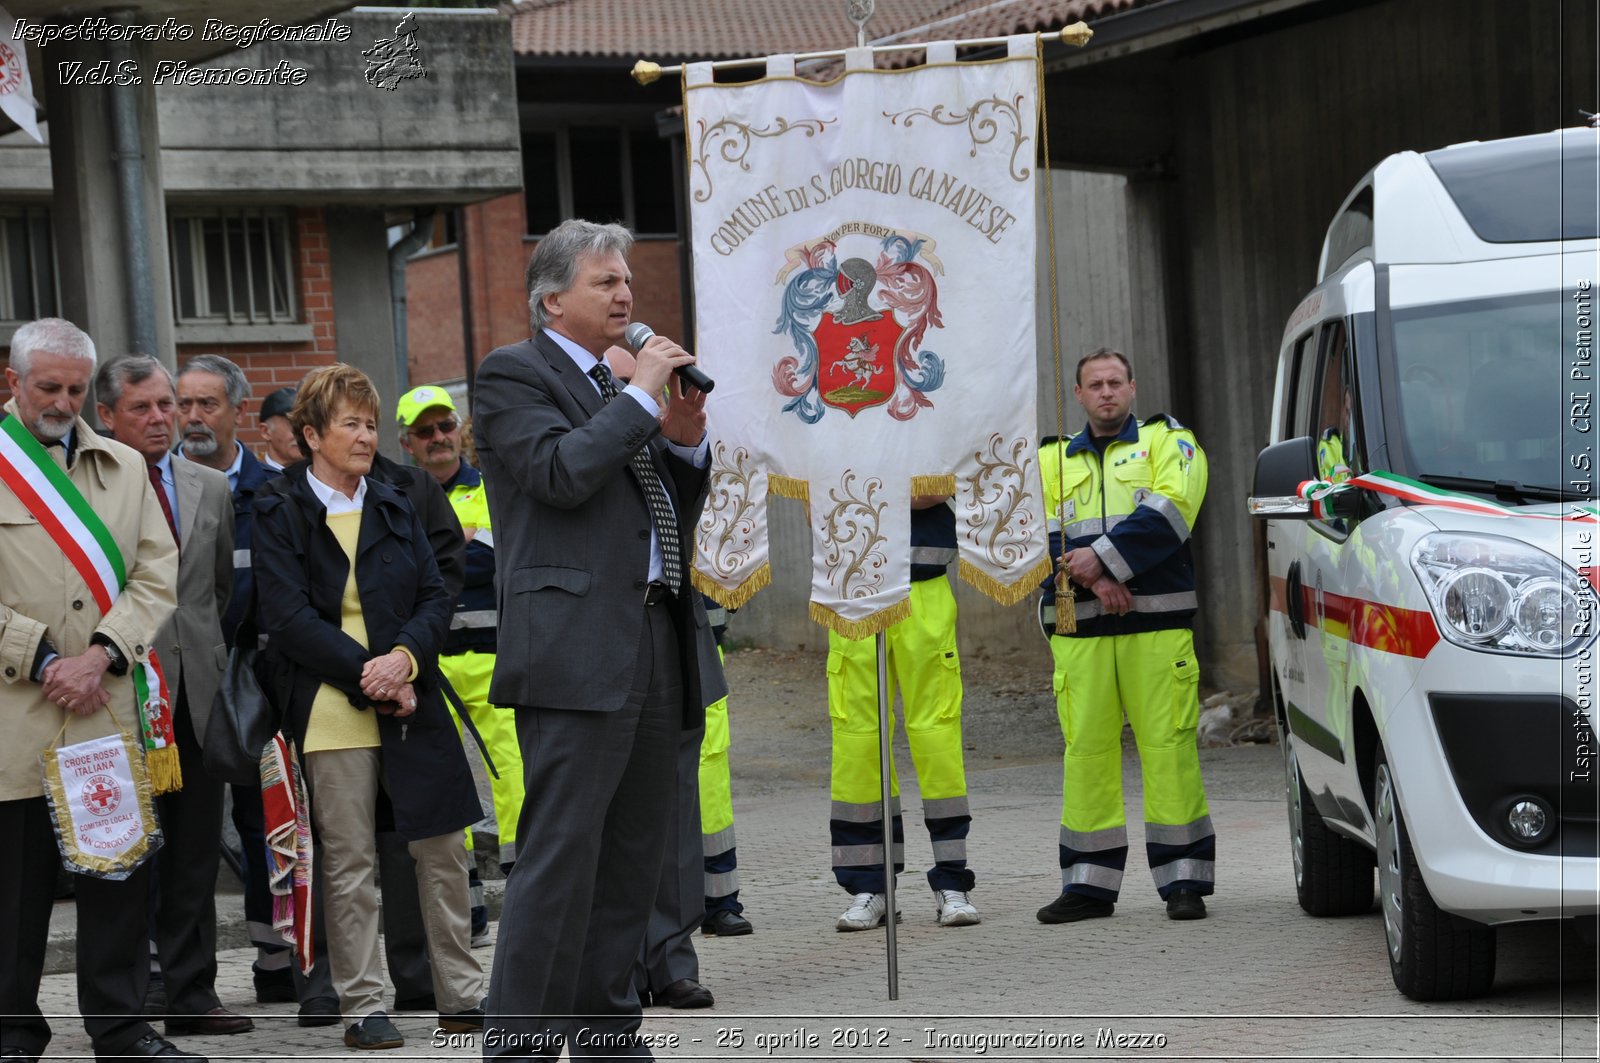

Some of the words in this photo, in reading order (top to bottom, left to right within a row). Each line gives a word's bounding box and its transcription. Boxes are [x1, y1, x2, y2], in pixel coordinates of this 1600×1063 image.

[710, 184, 788, 257] COMUNE
[787, 186, 811, 213] DI
[908, 166, 1018, 245] CANAVESE
[841, 222, 860, 235] PER
[863, 223, 896, 238] FORZA
[64, 755, 92, 768] CROCE
[94, 748, 120, 762] ROSSA
[75, 761, 114, 776] ITALIANA
[79, 818, 109, 832] COMITATO
[111, 813, 134, 825] LOCALE
[79, 834, 93, 847] SAN
[94, 836, 123, 849] GIORGIO
